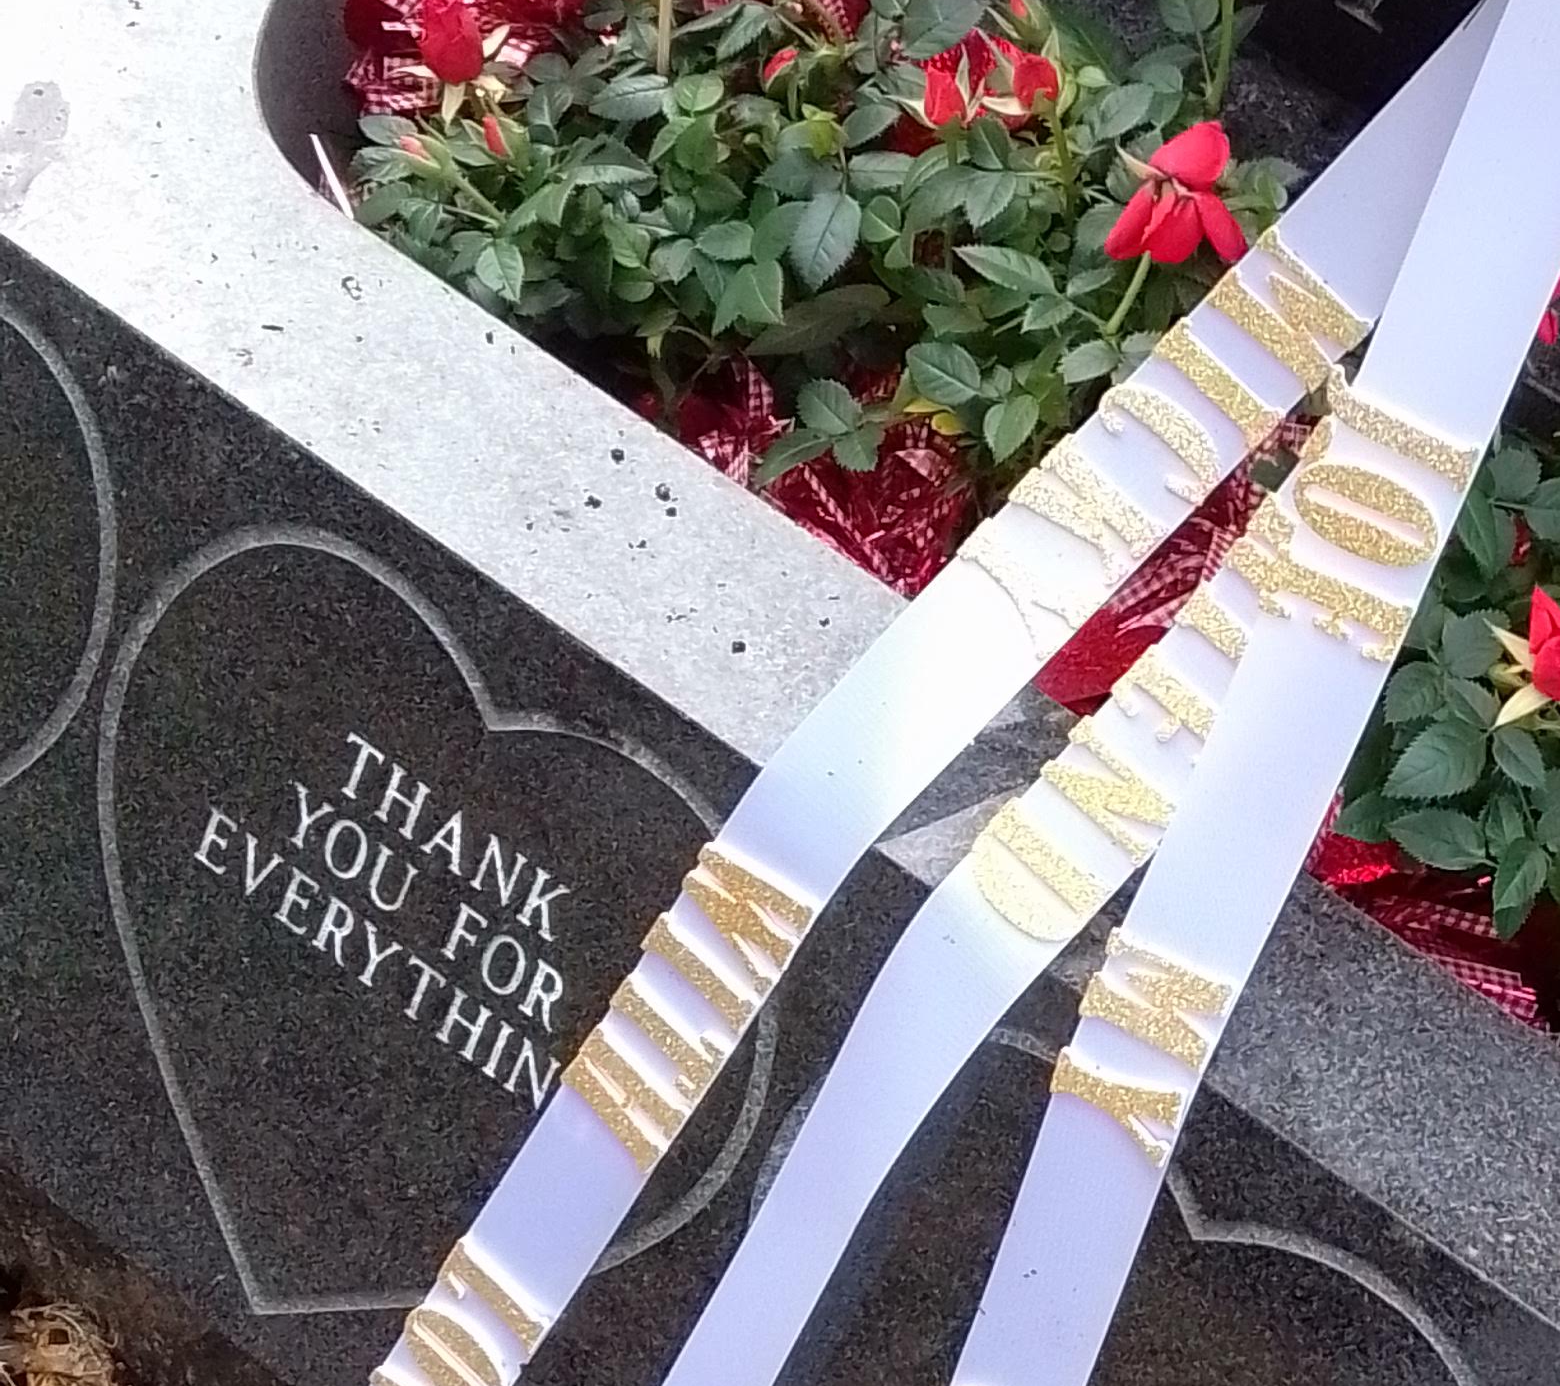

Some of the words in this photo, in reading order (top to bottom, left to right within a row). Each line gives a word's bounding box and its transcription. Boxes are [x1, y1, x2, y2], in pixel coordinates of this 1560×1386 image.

[958, 225, 1372, 660] MICKY
[1258, 363, 1482, 663] JOE
[194, 810, 562, 1111] EVERYTHIN
[288, 782, 419, 912] YOU
[441, 903, 564, 1032] FOR
[346, 732, 570, 941] THANK
[561, 841, 816, 1173] WITH
[1050, 926, 1234, 1167] MY
